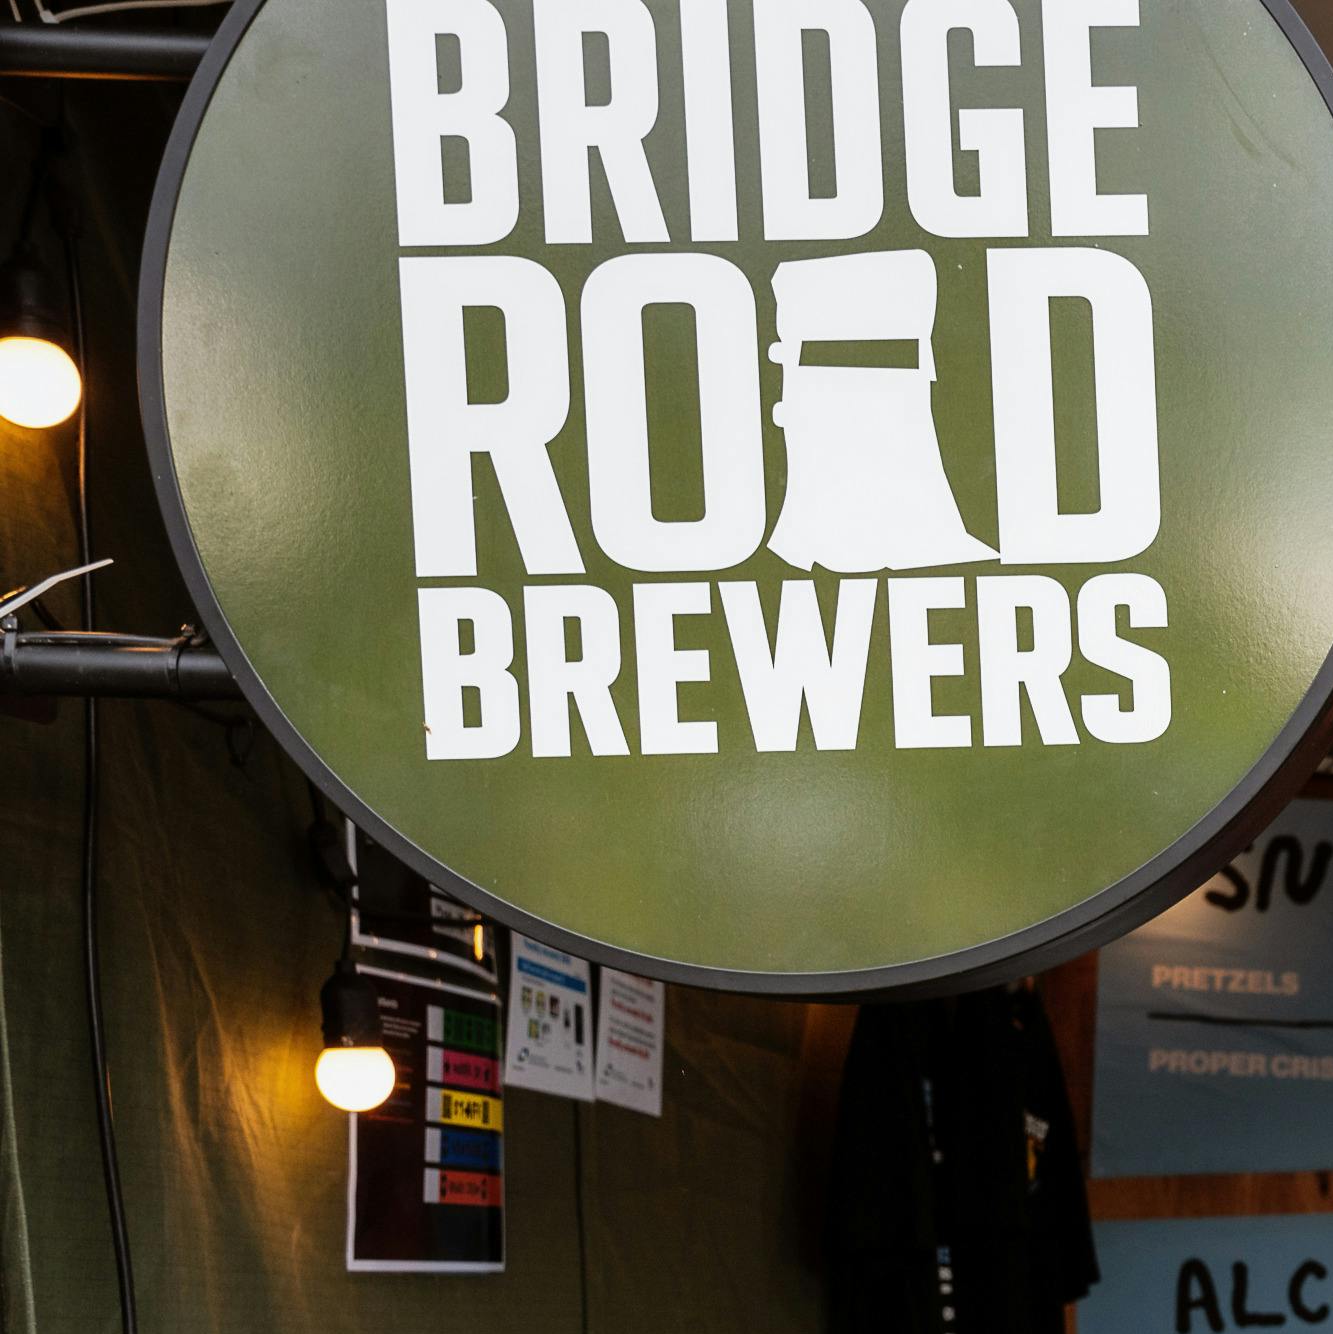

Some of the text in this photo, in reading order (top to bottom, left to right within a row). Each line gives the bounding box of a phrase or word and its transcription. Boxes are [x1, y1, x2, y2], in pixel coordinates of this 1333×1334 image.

[386, 0, 1149, 247] BRIDGE
[417, 573, 1172, 760] BREWERS
[1151, 964, 1299, 996] PRETZELS
[1149, 1050, 1269, 1077] PROPER
